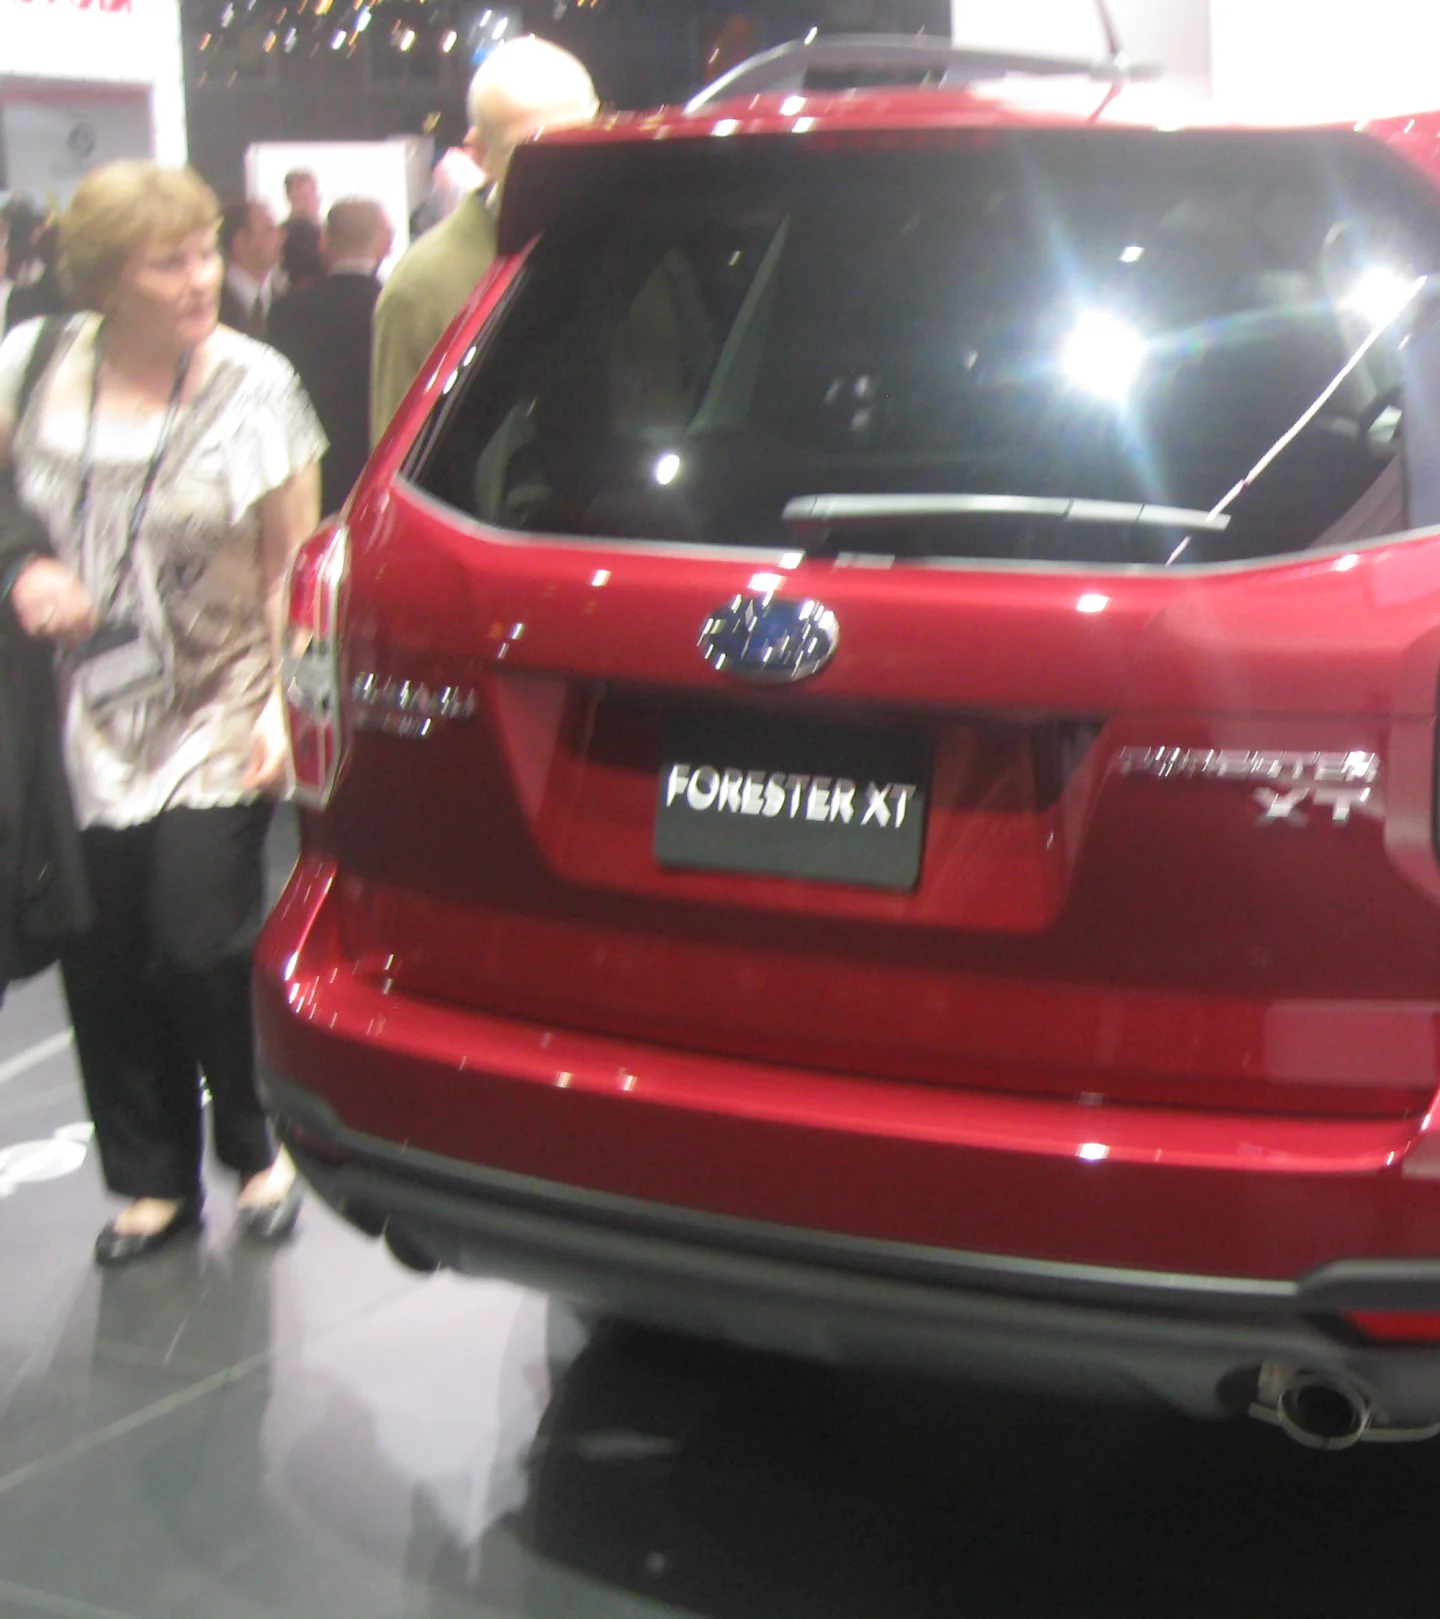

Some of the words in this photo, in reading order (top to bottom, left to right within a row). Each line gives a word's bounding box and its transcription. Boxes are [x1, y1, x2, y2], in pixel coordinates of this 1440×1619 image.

[666, 763, 856, 824] FORESTER
[860, 780, 917, 829] XT
[1251, 786, 1371, 828] XT
